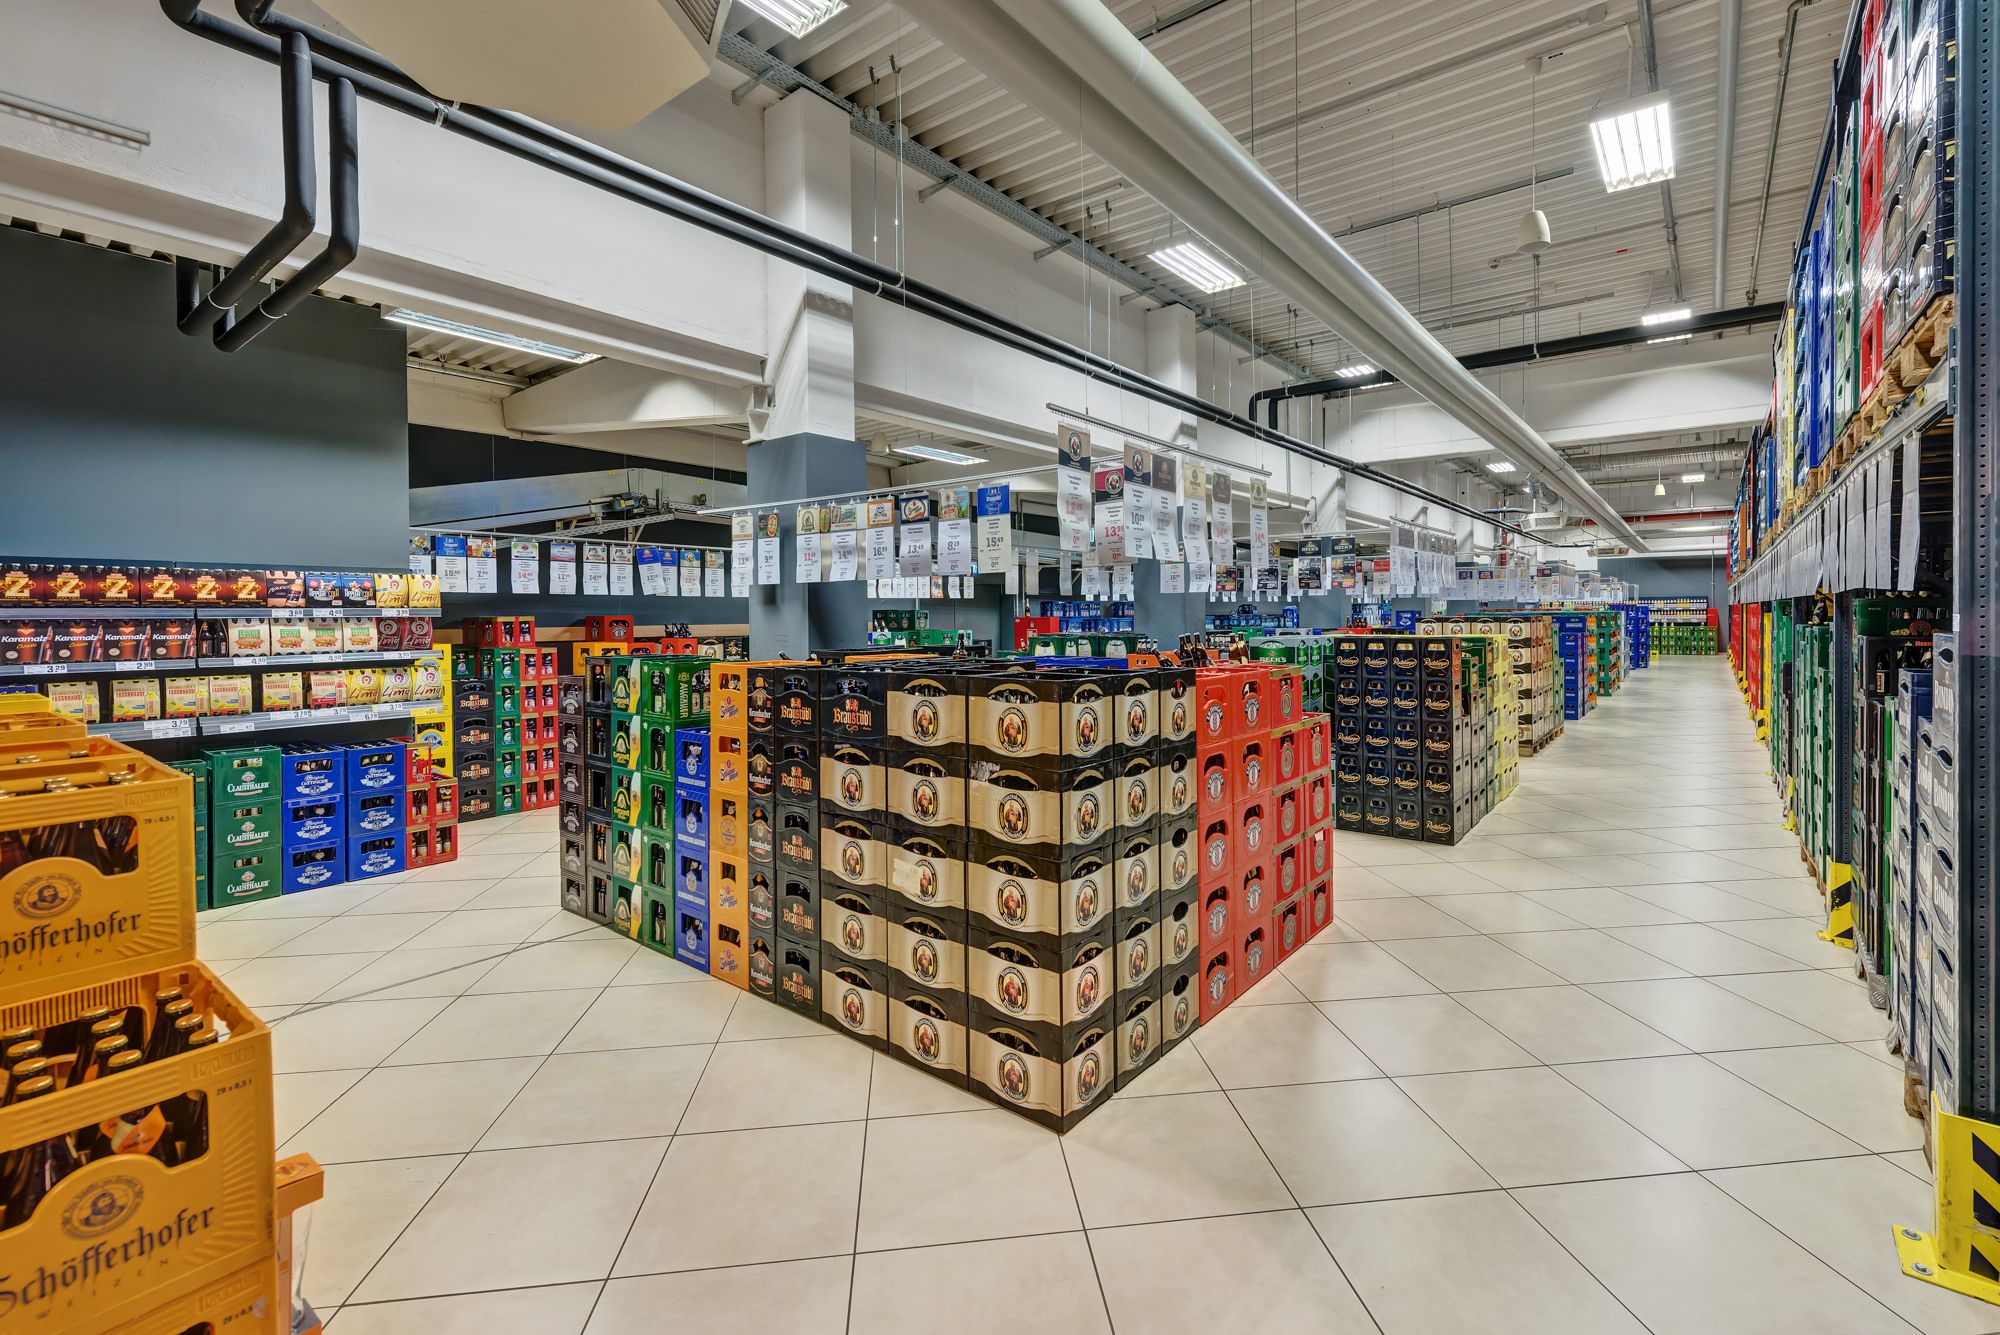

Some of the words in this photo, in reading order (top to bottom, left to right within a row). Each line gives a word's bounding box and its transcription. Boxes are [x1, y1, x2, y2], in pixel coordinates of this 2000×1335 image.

[1, 635, 48, 643] Karamalz
[105, 633, 146, 641] Karamalz
[414, 685, 441, 697] Limo
